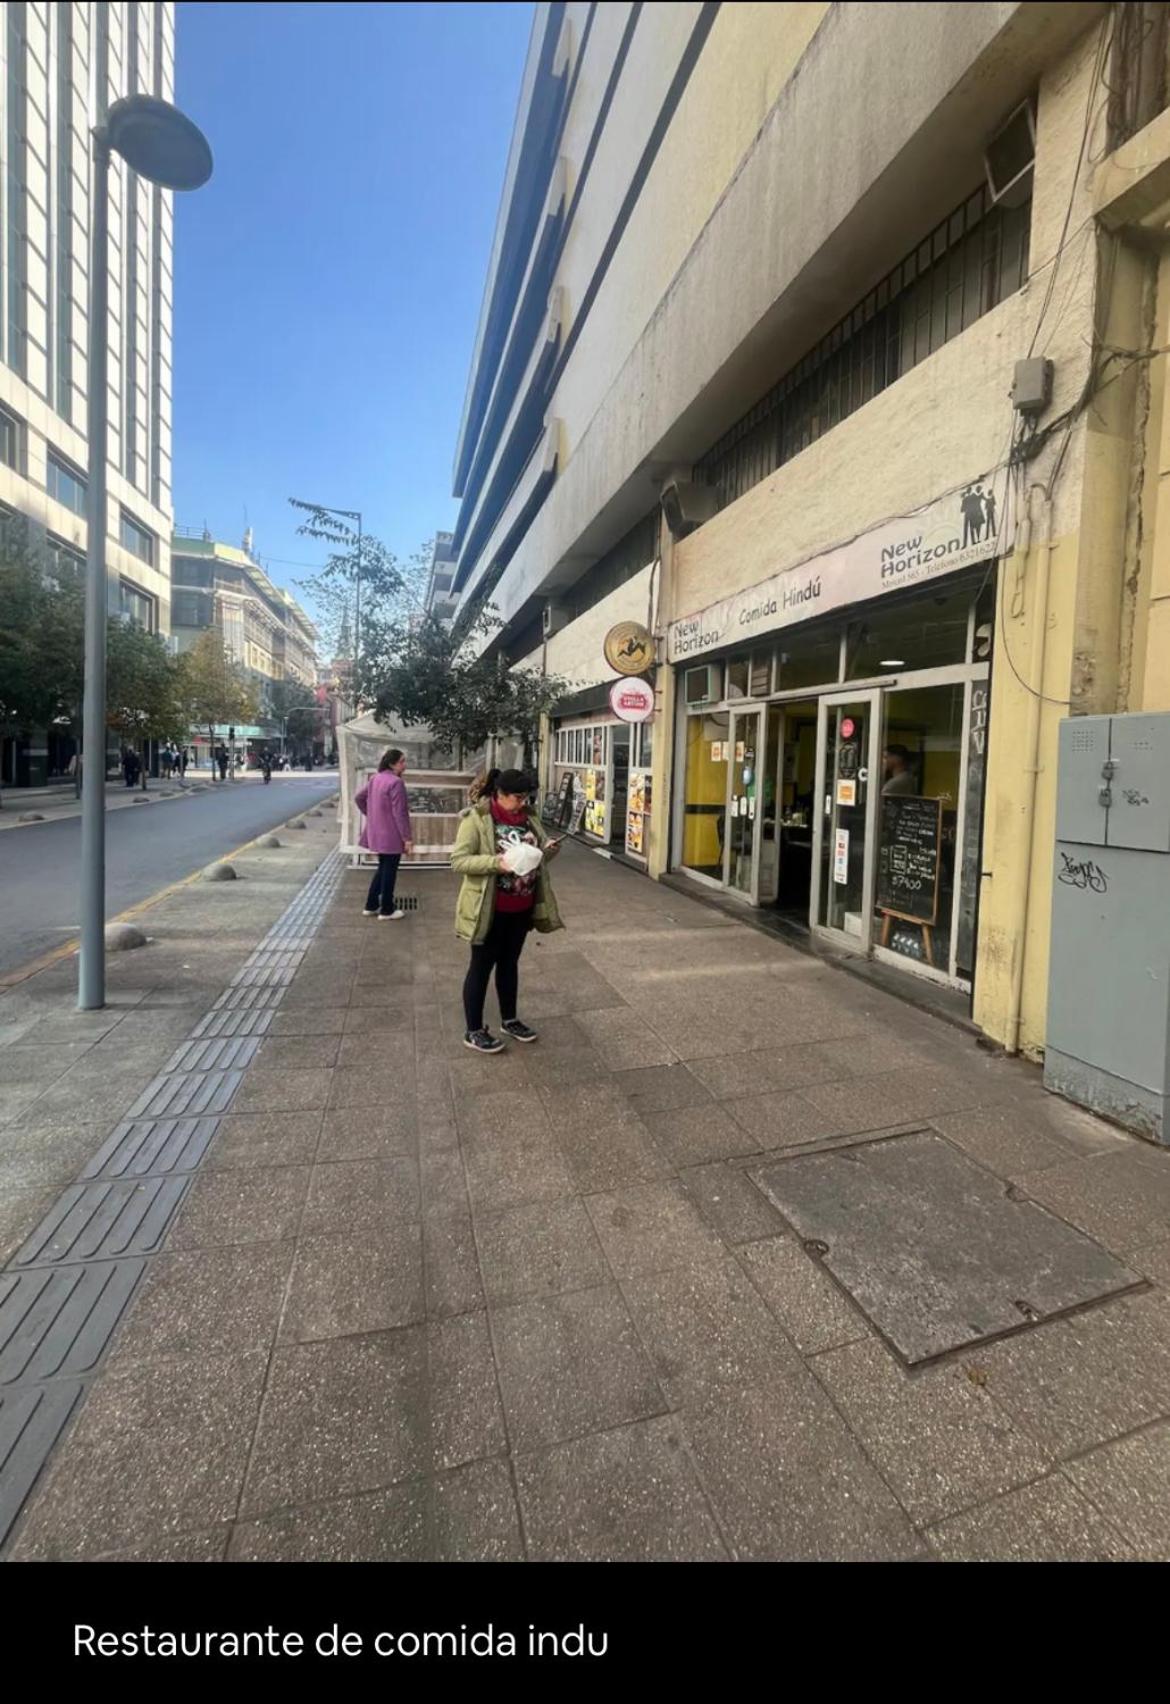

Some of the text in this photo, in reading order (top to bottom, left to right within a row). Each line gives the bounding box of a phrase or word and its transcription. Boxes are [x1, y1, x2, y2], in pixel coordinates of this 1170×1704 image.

[881, 536, 922, 562] New
[881, 539, 960, 578] Horizon
[739, 576, 821, 625] Comida Hindú
[674, 621, 699, 639] New
[674, 631, 719, 655] Horizon
